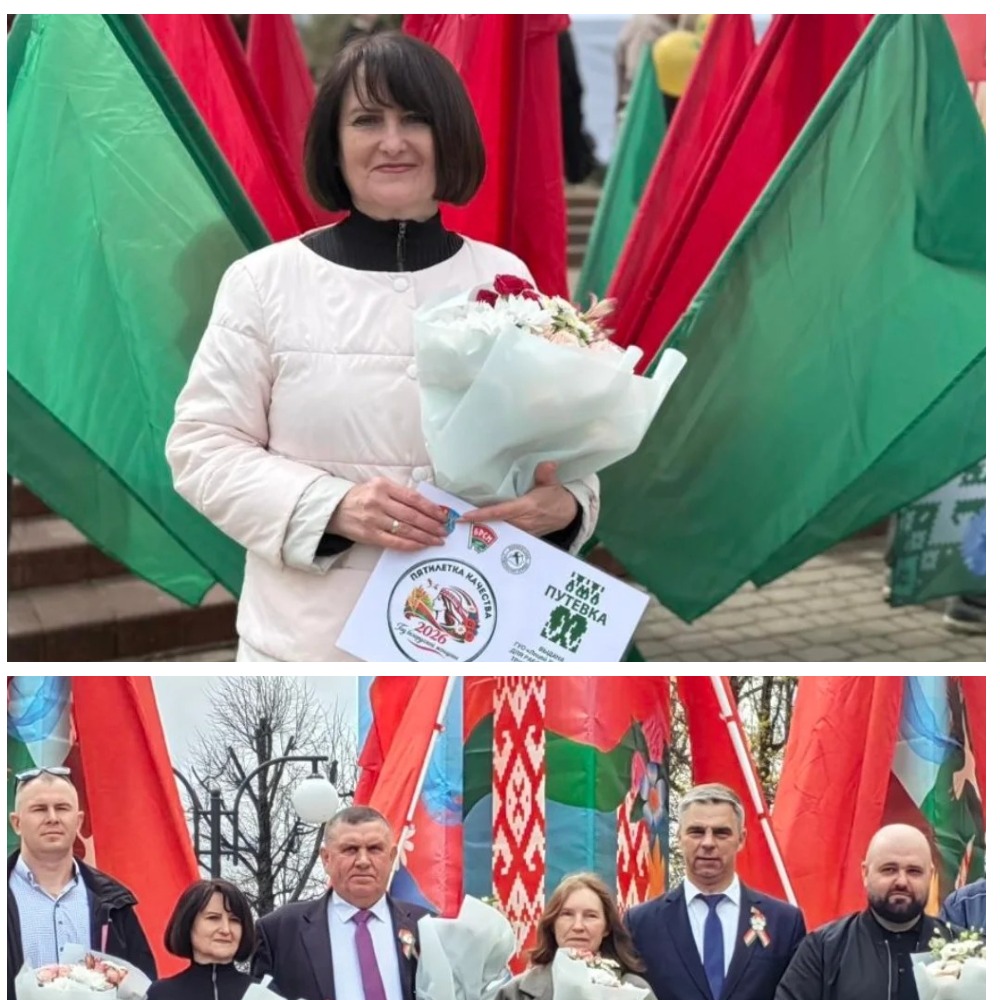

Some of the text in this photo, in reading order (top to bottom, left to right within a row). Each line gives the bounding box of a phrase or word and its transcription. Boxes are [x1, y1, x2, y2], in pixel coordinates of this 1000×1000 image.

[473, 527, 493, 543] БРСМ
[410, 564, 492, 619] ПЯТИЛЕТКА КАЧЕСТВА
[544, 585, 608, 626] ПУТЕВКА
[414, 622, 447, 644] 2026
